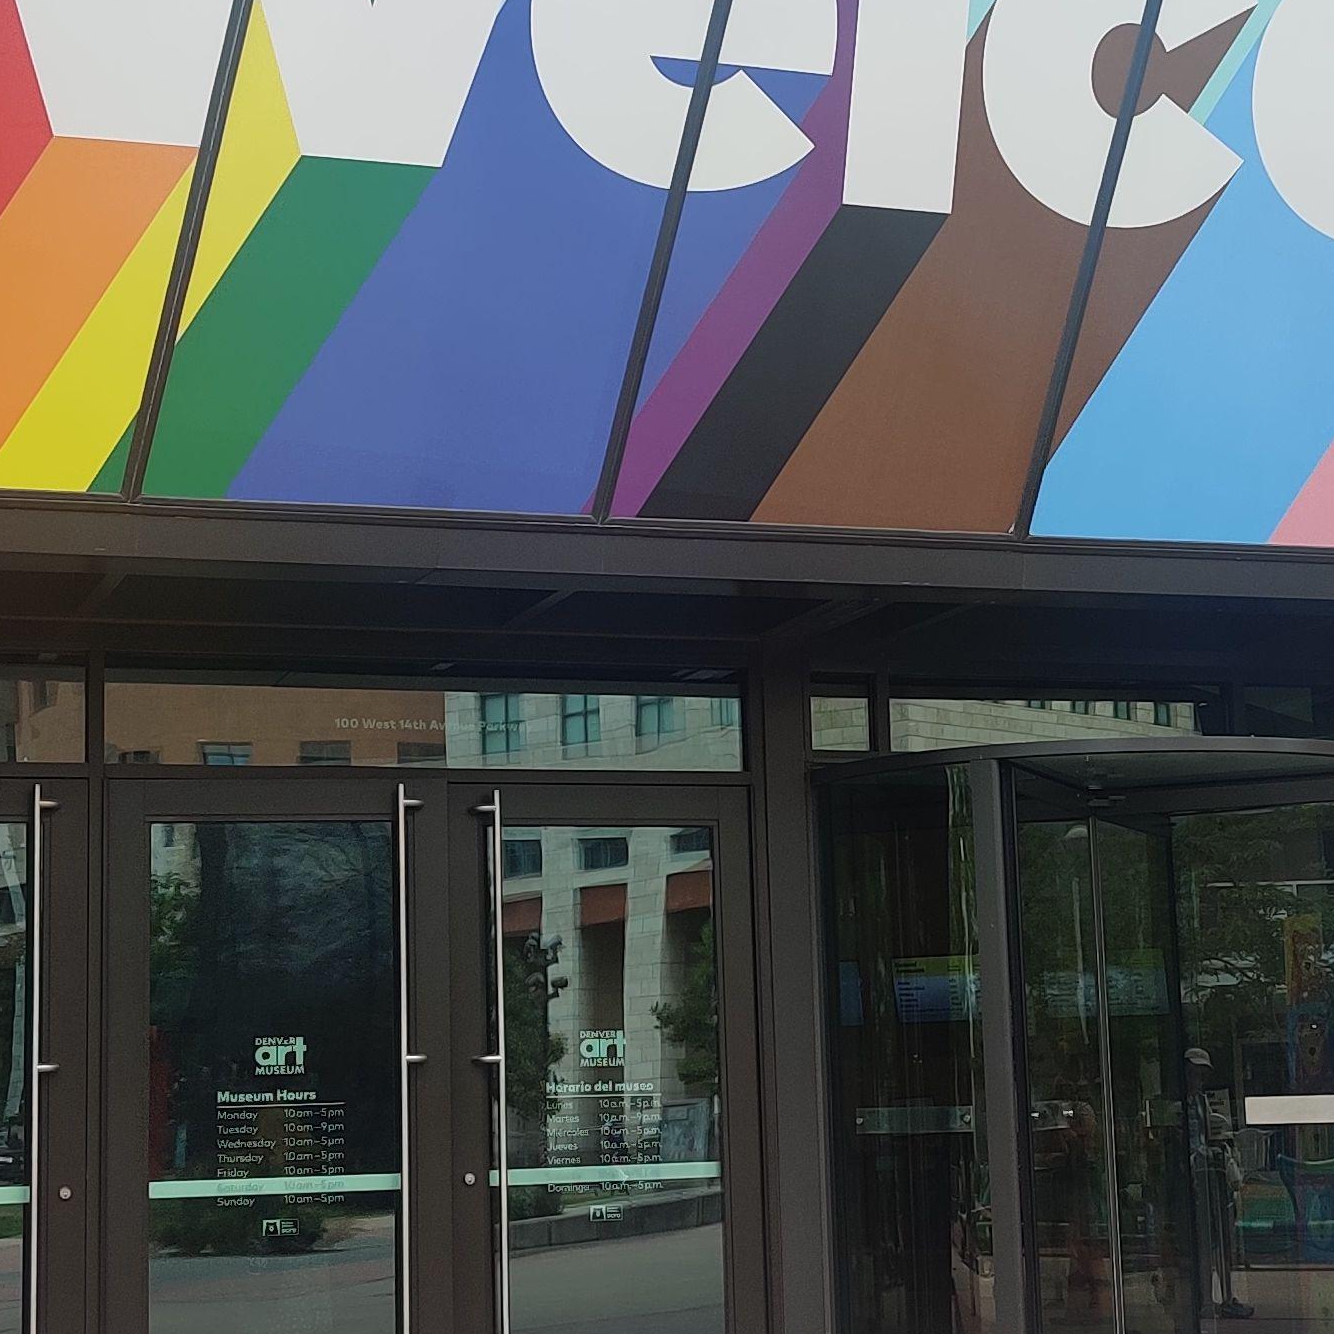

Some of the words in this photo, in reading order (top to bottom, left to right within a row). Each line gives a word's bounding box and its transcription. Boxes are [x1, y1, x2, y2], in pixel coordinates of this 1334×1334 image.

[335, 718, 358, 729] 100
[363, 719, 396, 730] West
[399, 720, 426, 730] 14th
[578, 1030, 616, 1039] DENVER
[579, 1030, 626, 1058] art
[255, 1036, 307, 1066] art
[579, 1057, 625, 1067] MUSEUM
[254, 1065, 305, 1075] MUSEUM
[546, 1081, 592, 1093] Horario
[594, 1080, 613, 1092] del
[615, 1082, 654, 1092] museo
[217, 1091, 274, 1103] Museum
[276, 1089, 317, 1101] Hours
[217, 1110, 258, 1121] Monday
[217, 1125, 258, 1135] Tuesday
[217, 1139, 276, 1149] Wednesday
[217, 1153, 264, 1164] Thursday
[217, 1168, 249, 1178] Friday
[217, 1196, 255, 1207] Sunday
